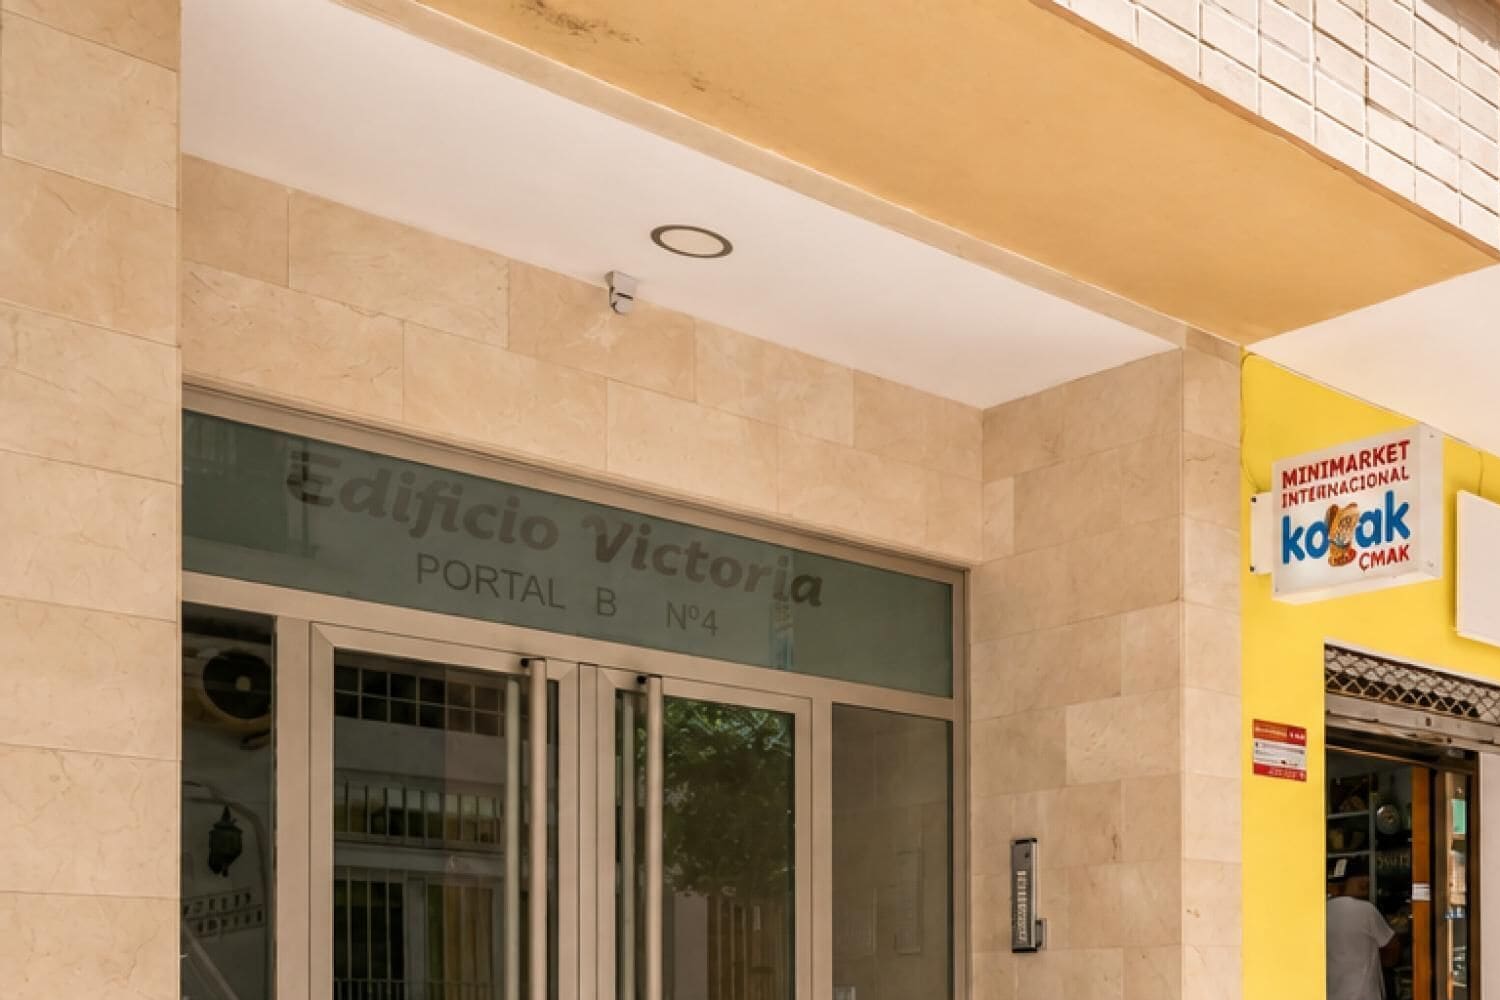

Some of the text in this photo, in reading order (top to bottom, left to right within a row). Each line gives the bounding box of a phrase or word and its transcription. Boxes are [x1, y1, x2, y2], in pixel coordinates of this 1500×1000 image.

[1282, 439, 1411, 488] MINIMARKET
[1282, 465, 1410, 509] INTERNACIONAL
[286, 449, 823, 608] Edificio Victoria
[1282, 490, 1411, 565] koak
[416, 552, 567, 610] PORTAL
[596, 586, 618, 618] B
